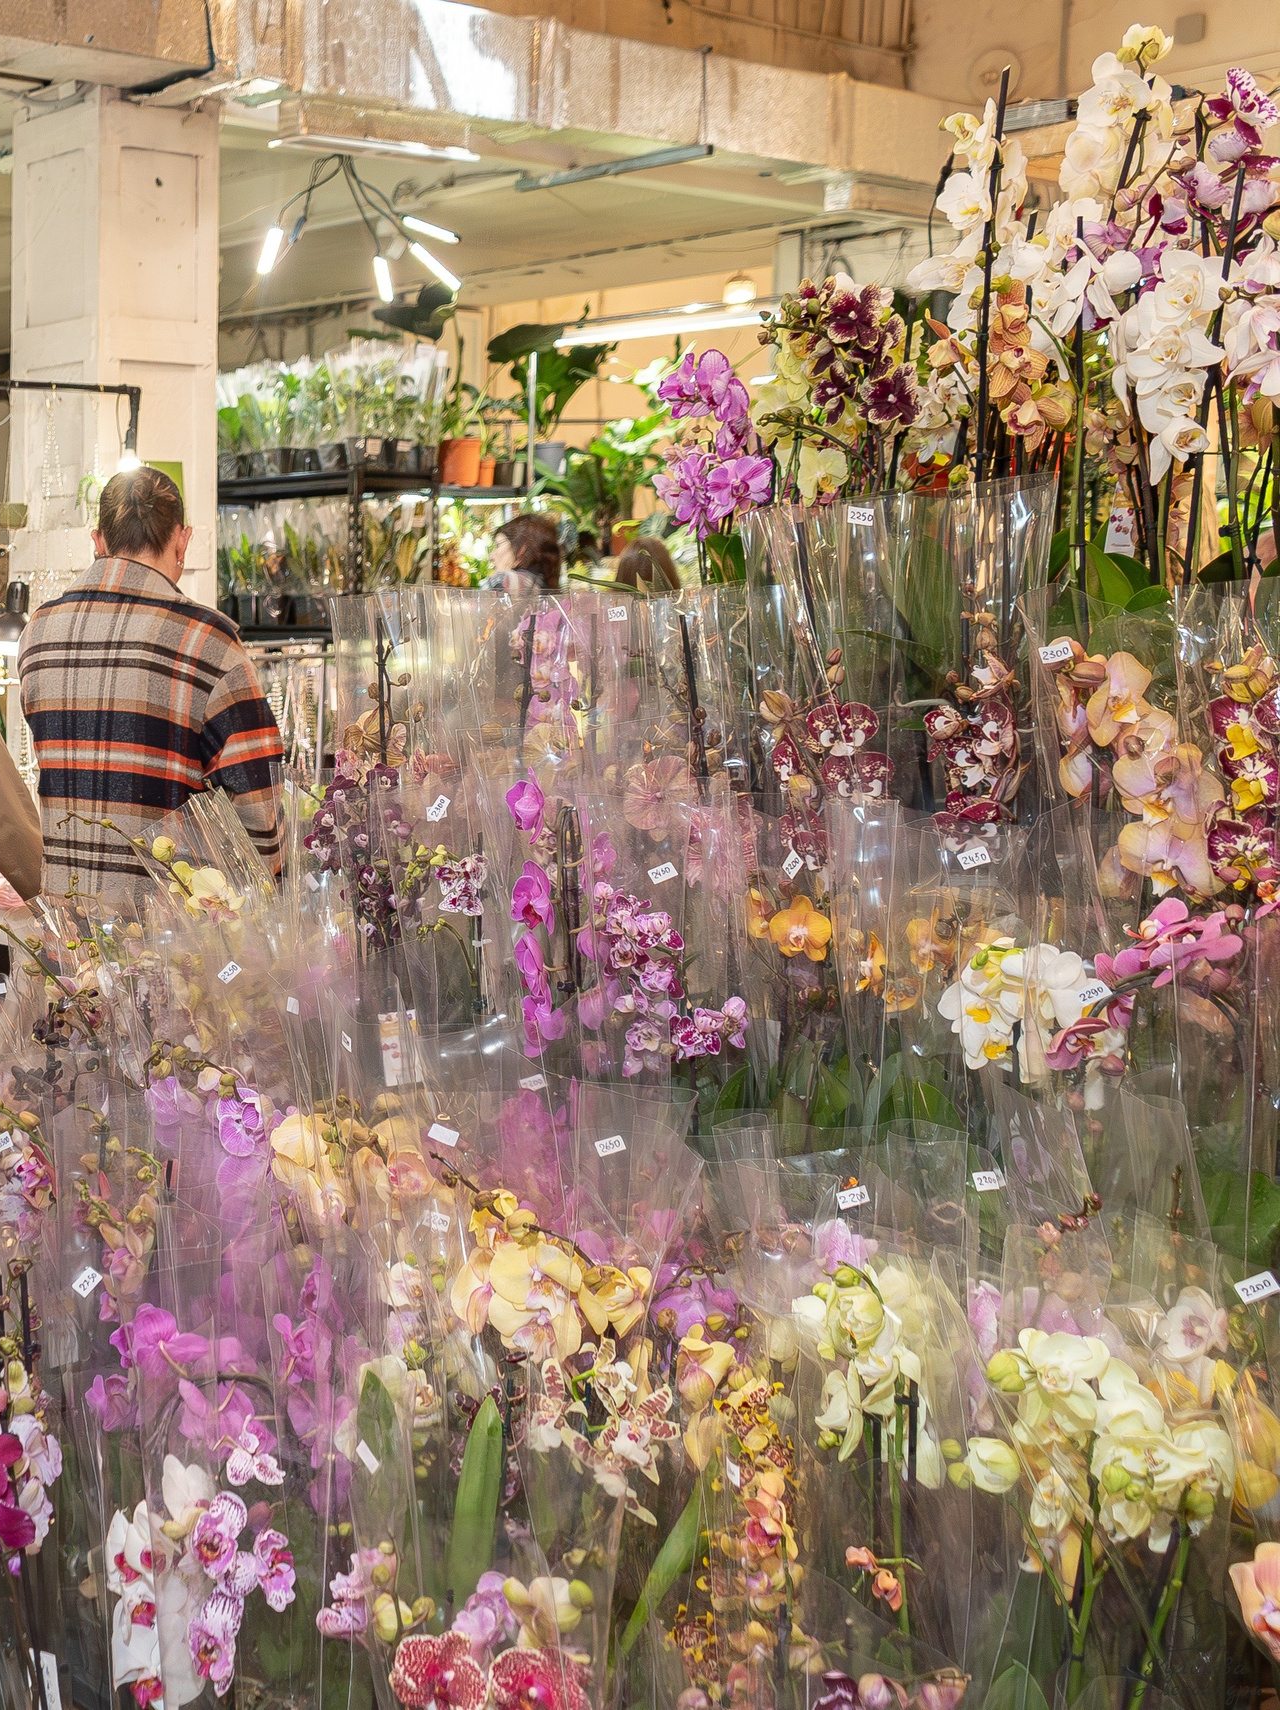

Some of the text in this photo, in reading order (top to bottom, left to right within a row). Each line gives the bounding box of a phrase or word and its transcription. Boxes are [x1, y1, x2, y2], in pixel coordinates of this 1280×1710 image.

[850, 511, 874, 522] 2250
[1042, 646, 1069, 660] 2300
[430, 798, 445, 818] 2300
[785, 857, 800, 875] 2200
[962, 852, 987, 866] 2450
[1079, 986, 1104, 1002] 2290
[599, 1139, 621, 1153] 2650
[978, 1176, 997, 1186] 2200
[839, 1191, 866, 1204] 2200
[1241, 1279, 1271, 1297] 2200
